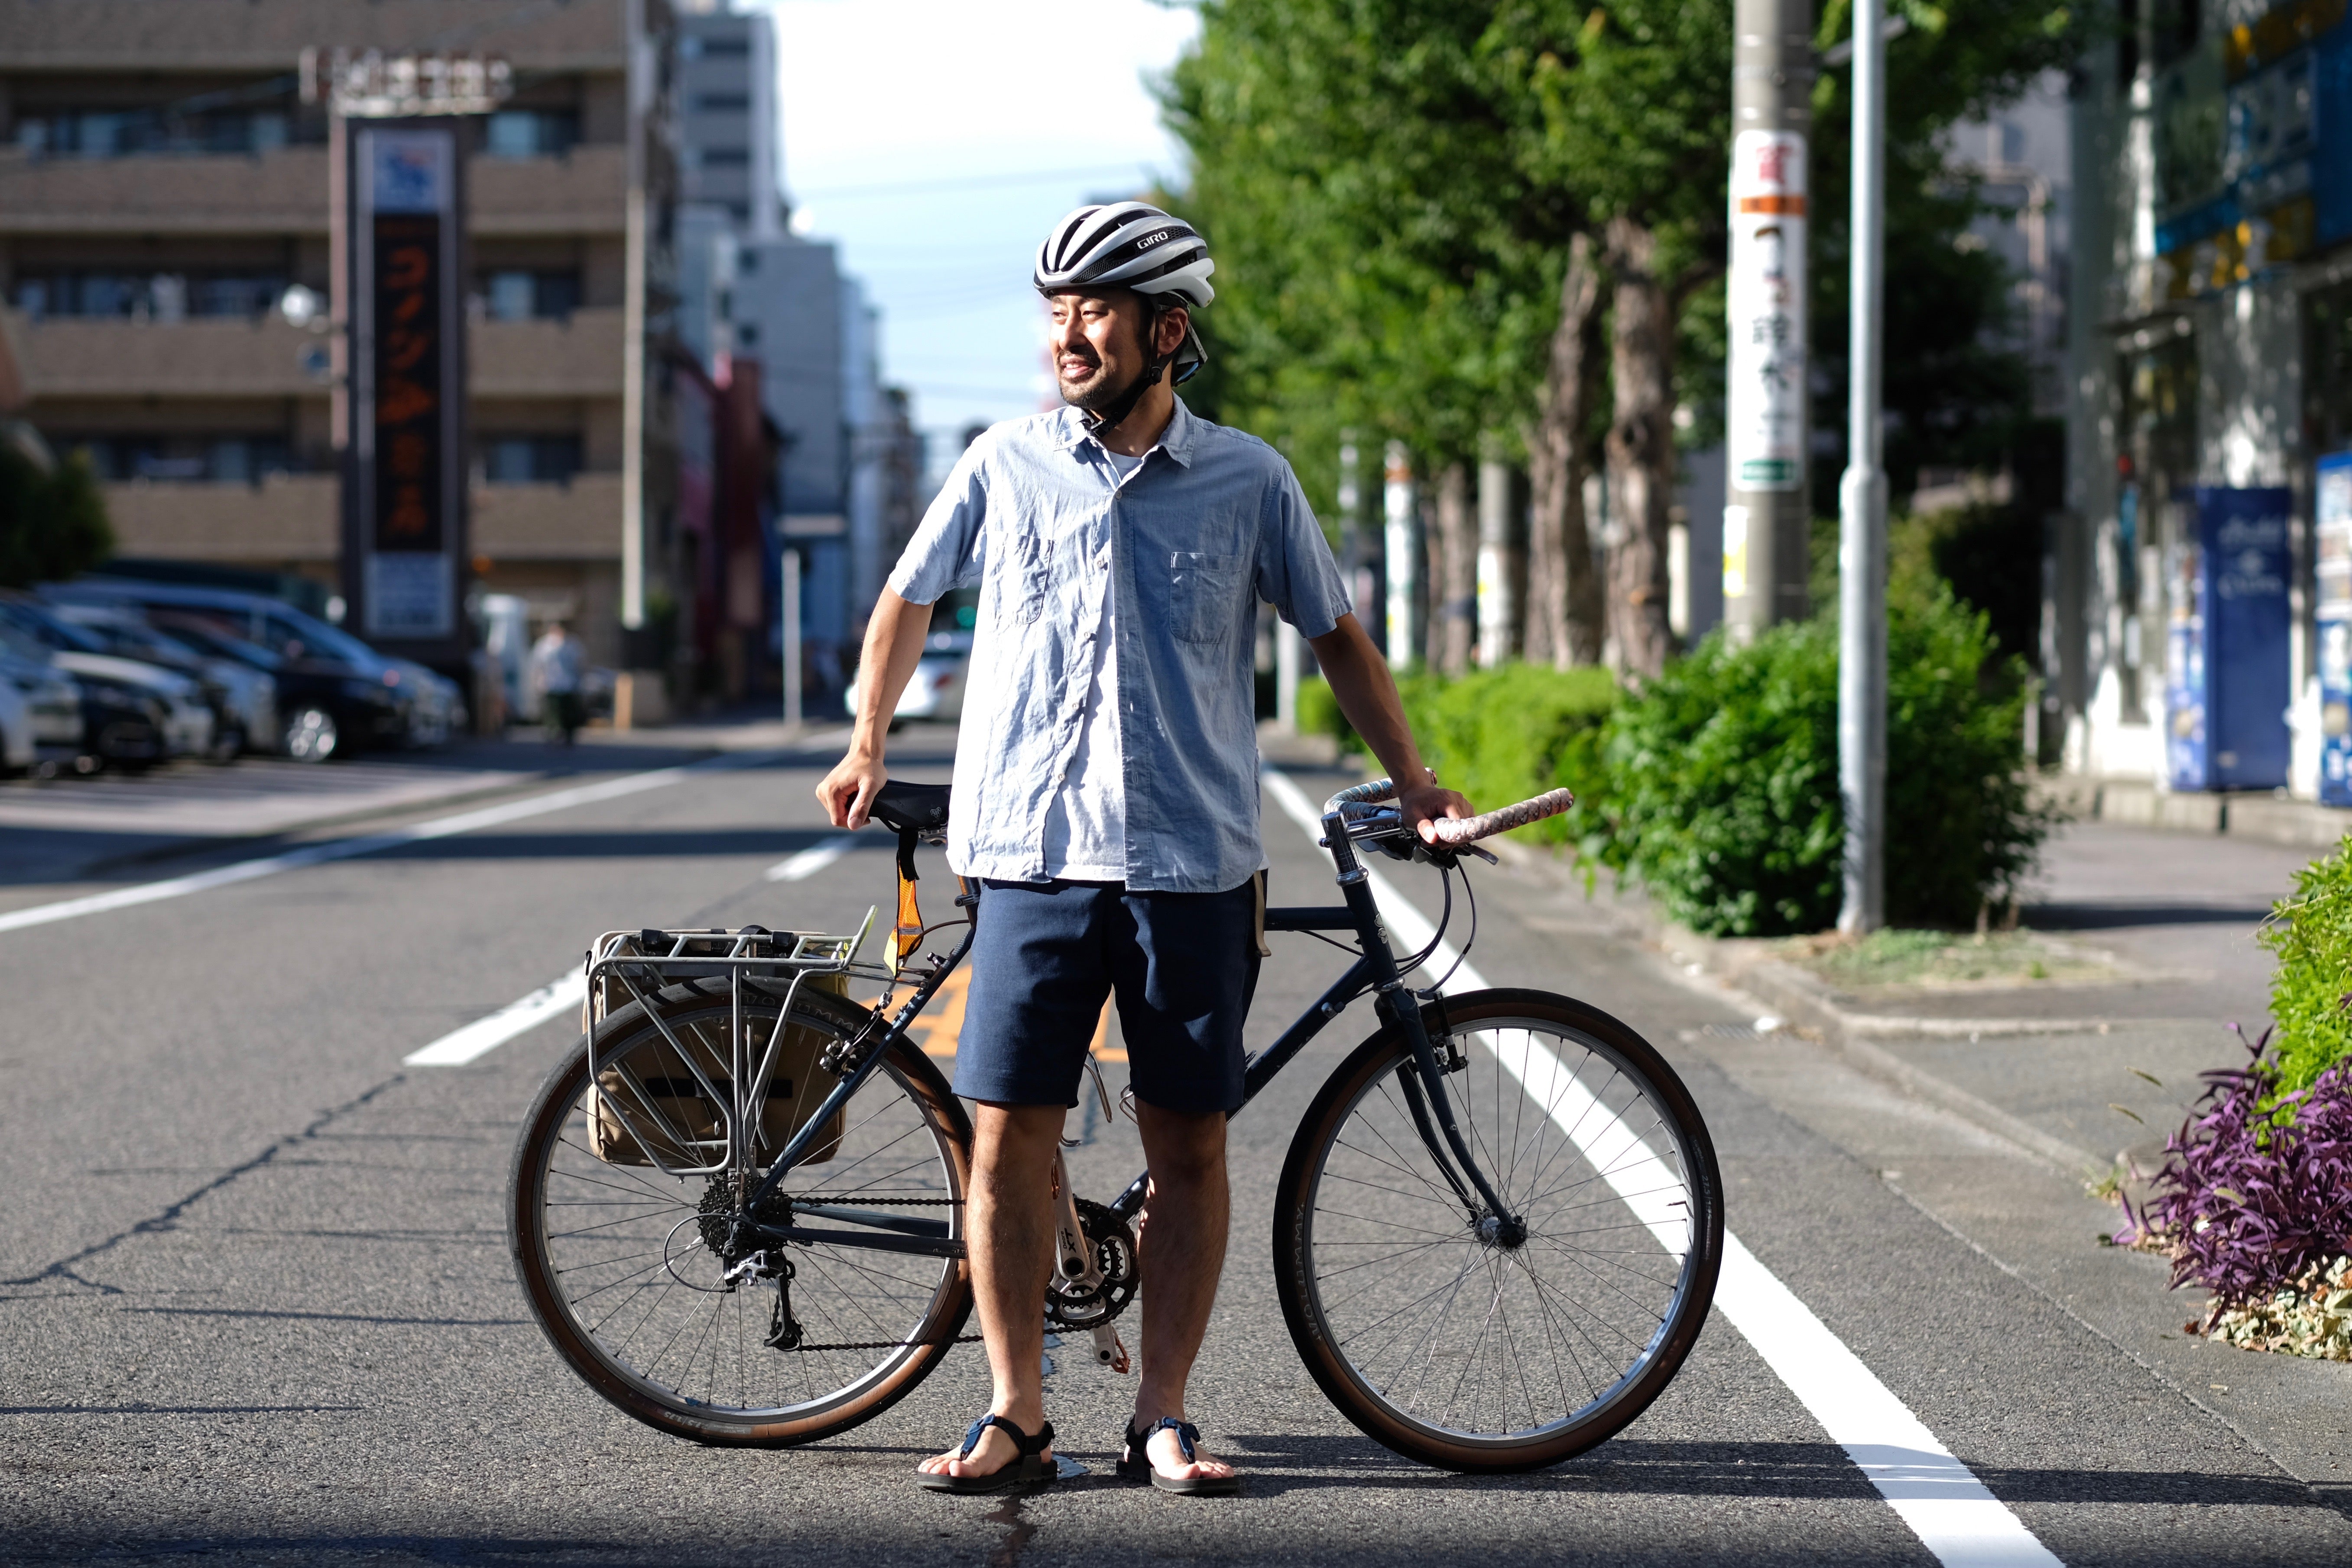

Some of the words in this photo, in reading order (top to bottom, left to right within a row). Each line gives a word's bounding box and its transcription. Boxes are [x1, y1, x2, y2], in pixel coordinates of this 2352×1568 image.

[1137, 231, 1168, 250] GIRO
[742, 996, 862, 1032] VOUMM
[1064, 1227, 1077, 1253] XT
[1294, 1206, 1320, 1336] VOLUMMY
